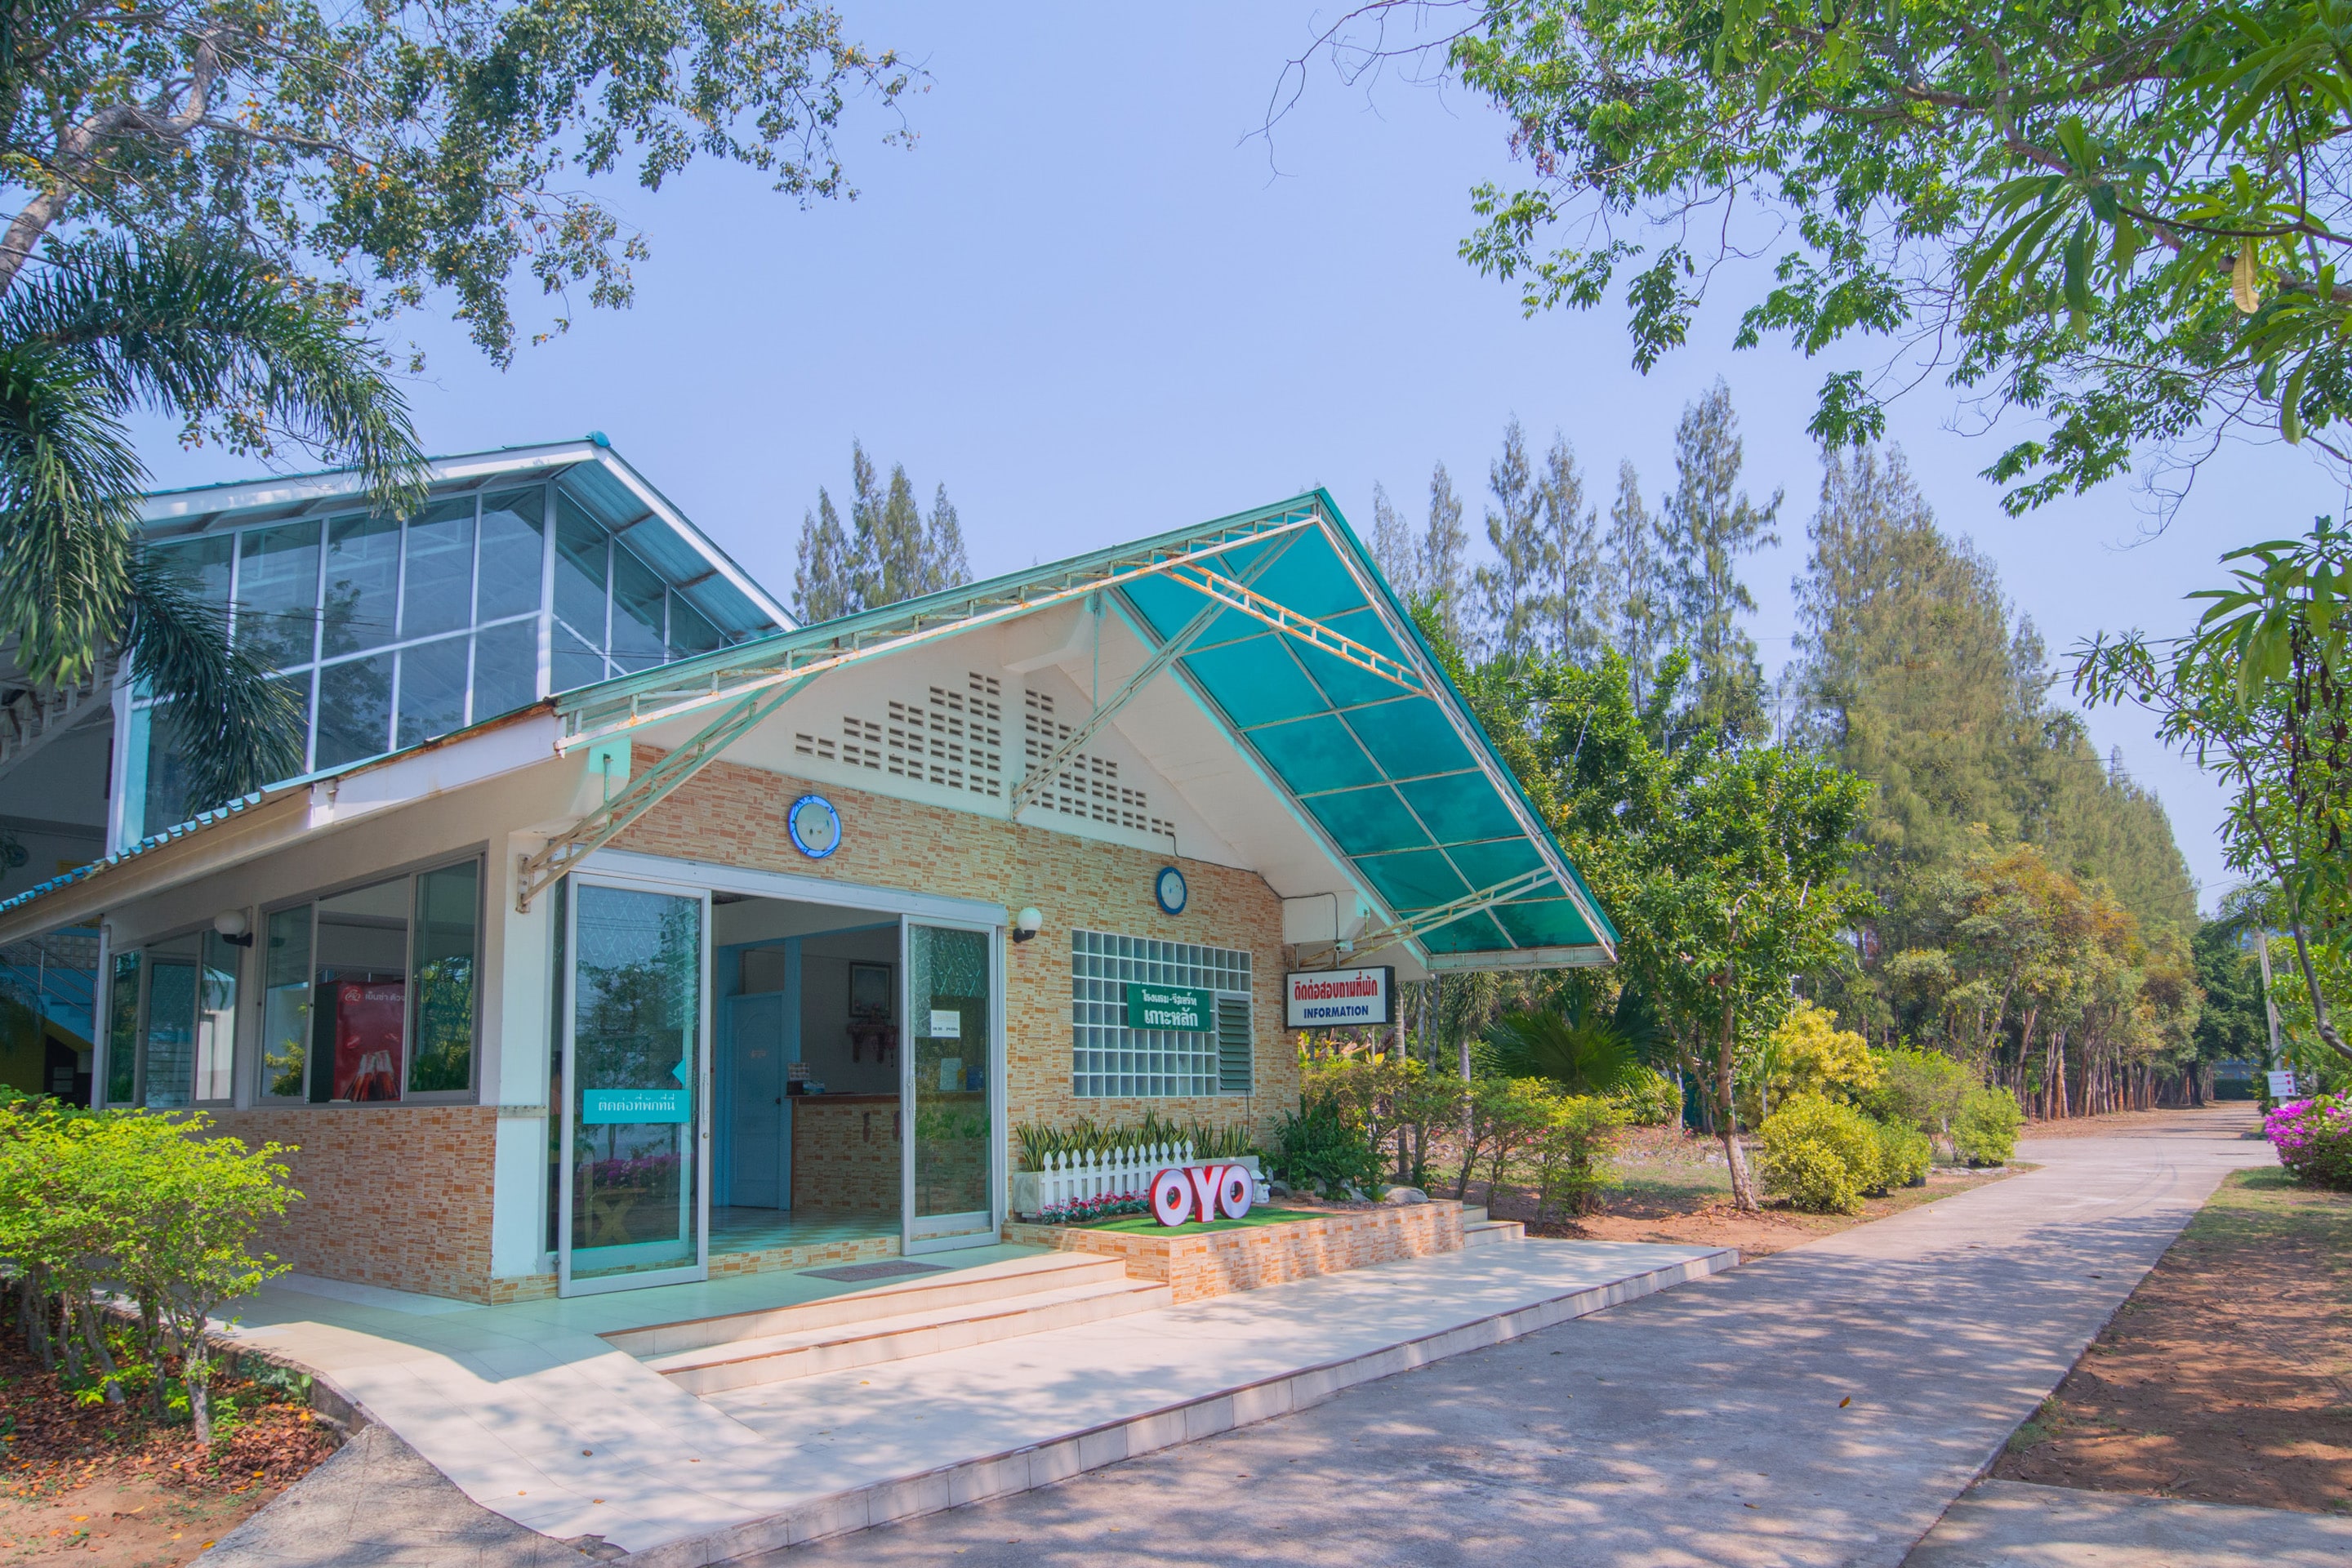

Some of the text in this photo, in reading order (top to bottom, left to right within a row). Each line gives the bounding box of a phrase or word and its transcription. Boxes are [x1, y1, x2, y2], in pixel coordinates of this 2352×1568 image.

[1294, 970, 1379, 1000] ติดต่อสอบถามที่พัก
[1144, 1007, 1199, 1027] เกาะหลัก
[1303, 1005, 1369, 1018] INFORMATION
[598, 1094, 676, 1111] ติดต่อที่พักที่นี่
[1149, 1164, 1254, 1227] OYO
